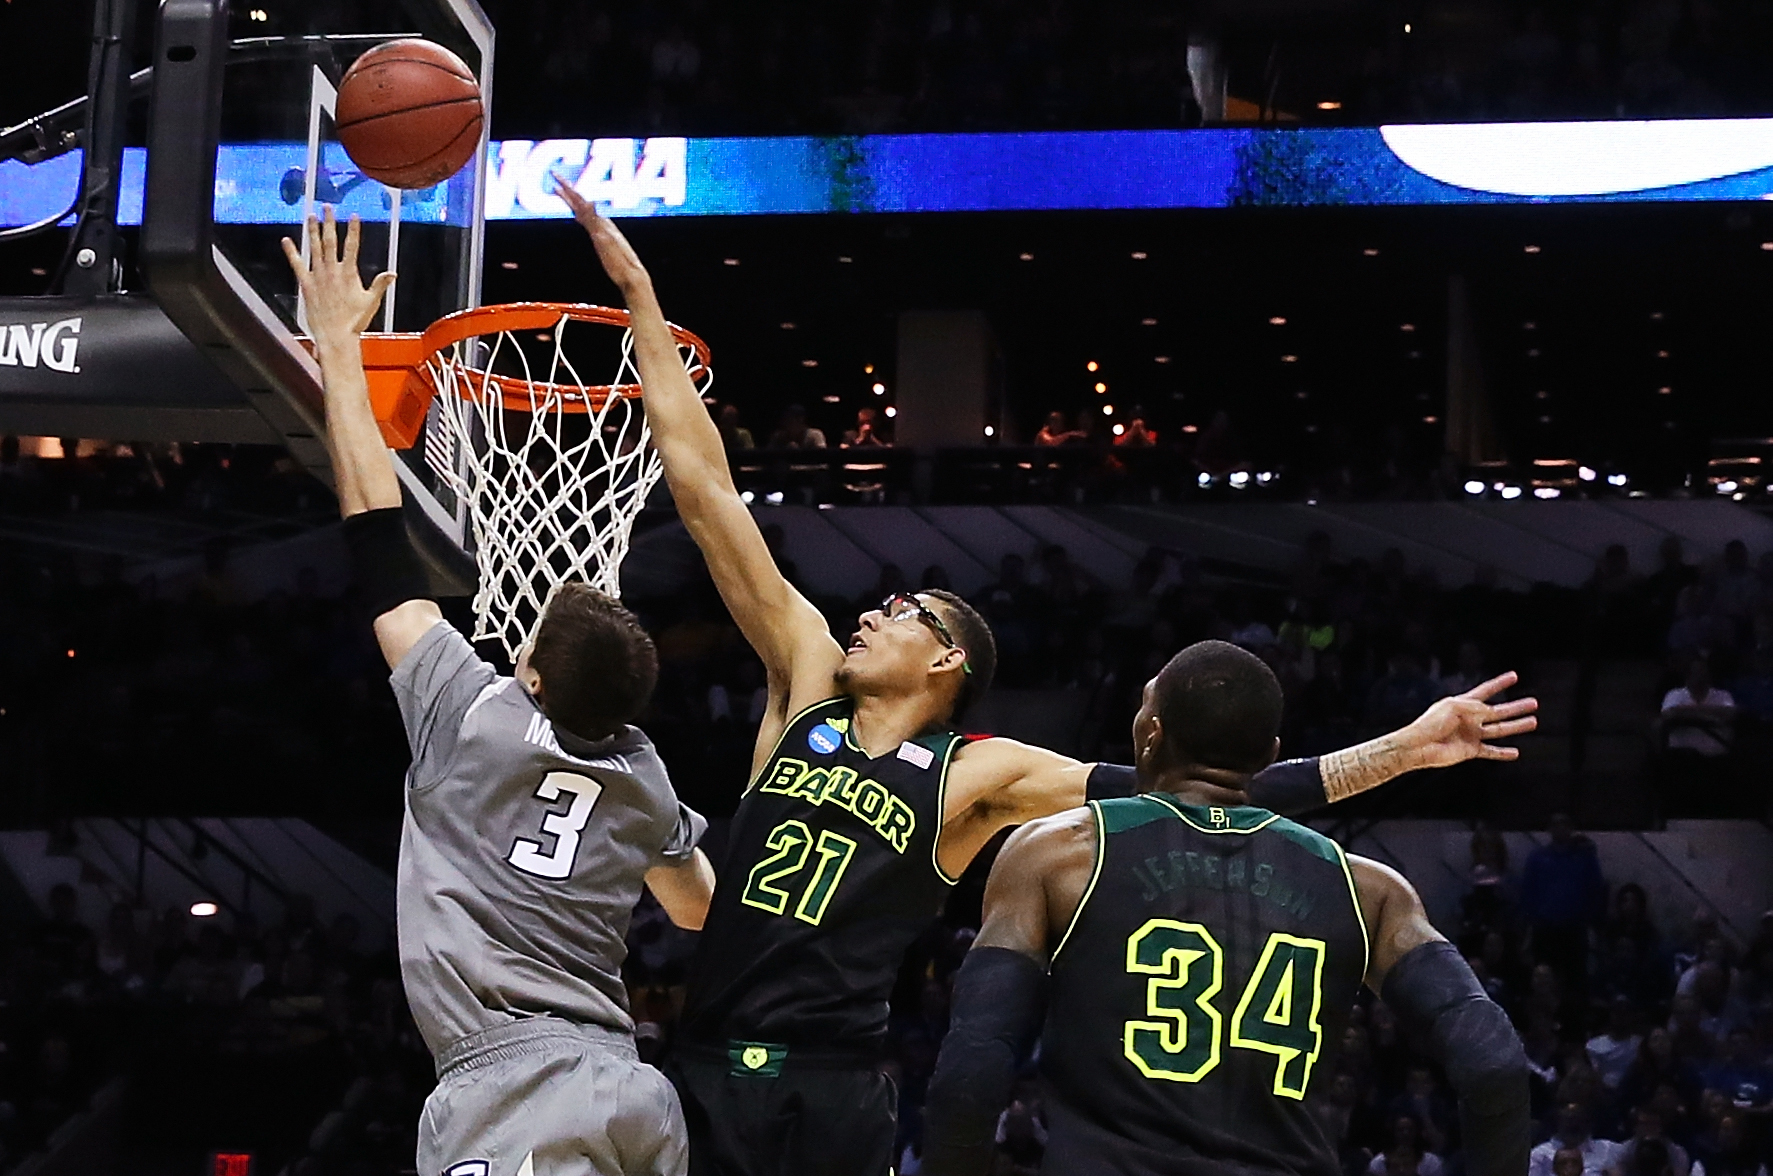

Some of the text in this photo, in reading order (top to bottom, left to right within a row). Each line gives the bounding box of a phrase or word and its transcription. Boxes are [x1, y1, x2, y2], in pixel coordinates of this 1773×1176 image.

[485, 137, 687, 219] NCAA
[507, 770, 605, 881] 3
[742, 820, 857, 927] 21
[1124, 919, 1326, 1099] 34
